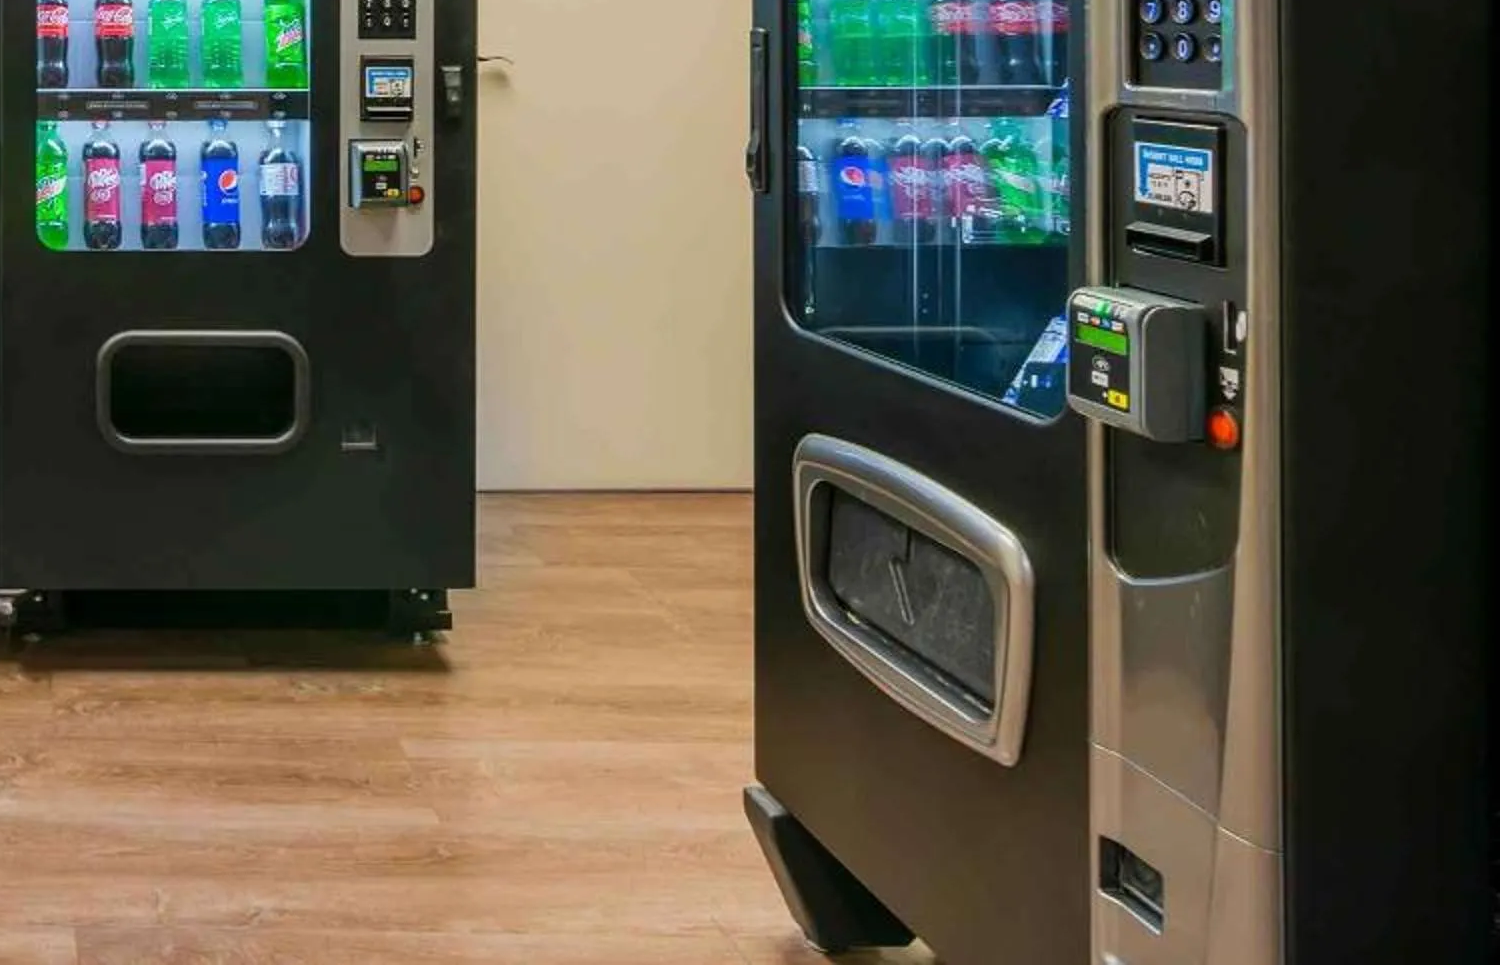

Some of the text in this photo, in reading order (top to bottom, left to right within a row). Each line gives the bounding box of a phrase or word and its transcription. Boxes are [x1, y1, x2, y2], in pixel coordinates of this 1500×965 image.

[1145, 1, 1221, 18] 7 8 9
[1177, 40, 1188, 57] 0
